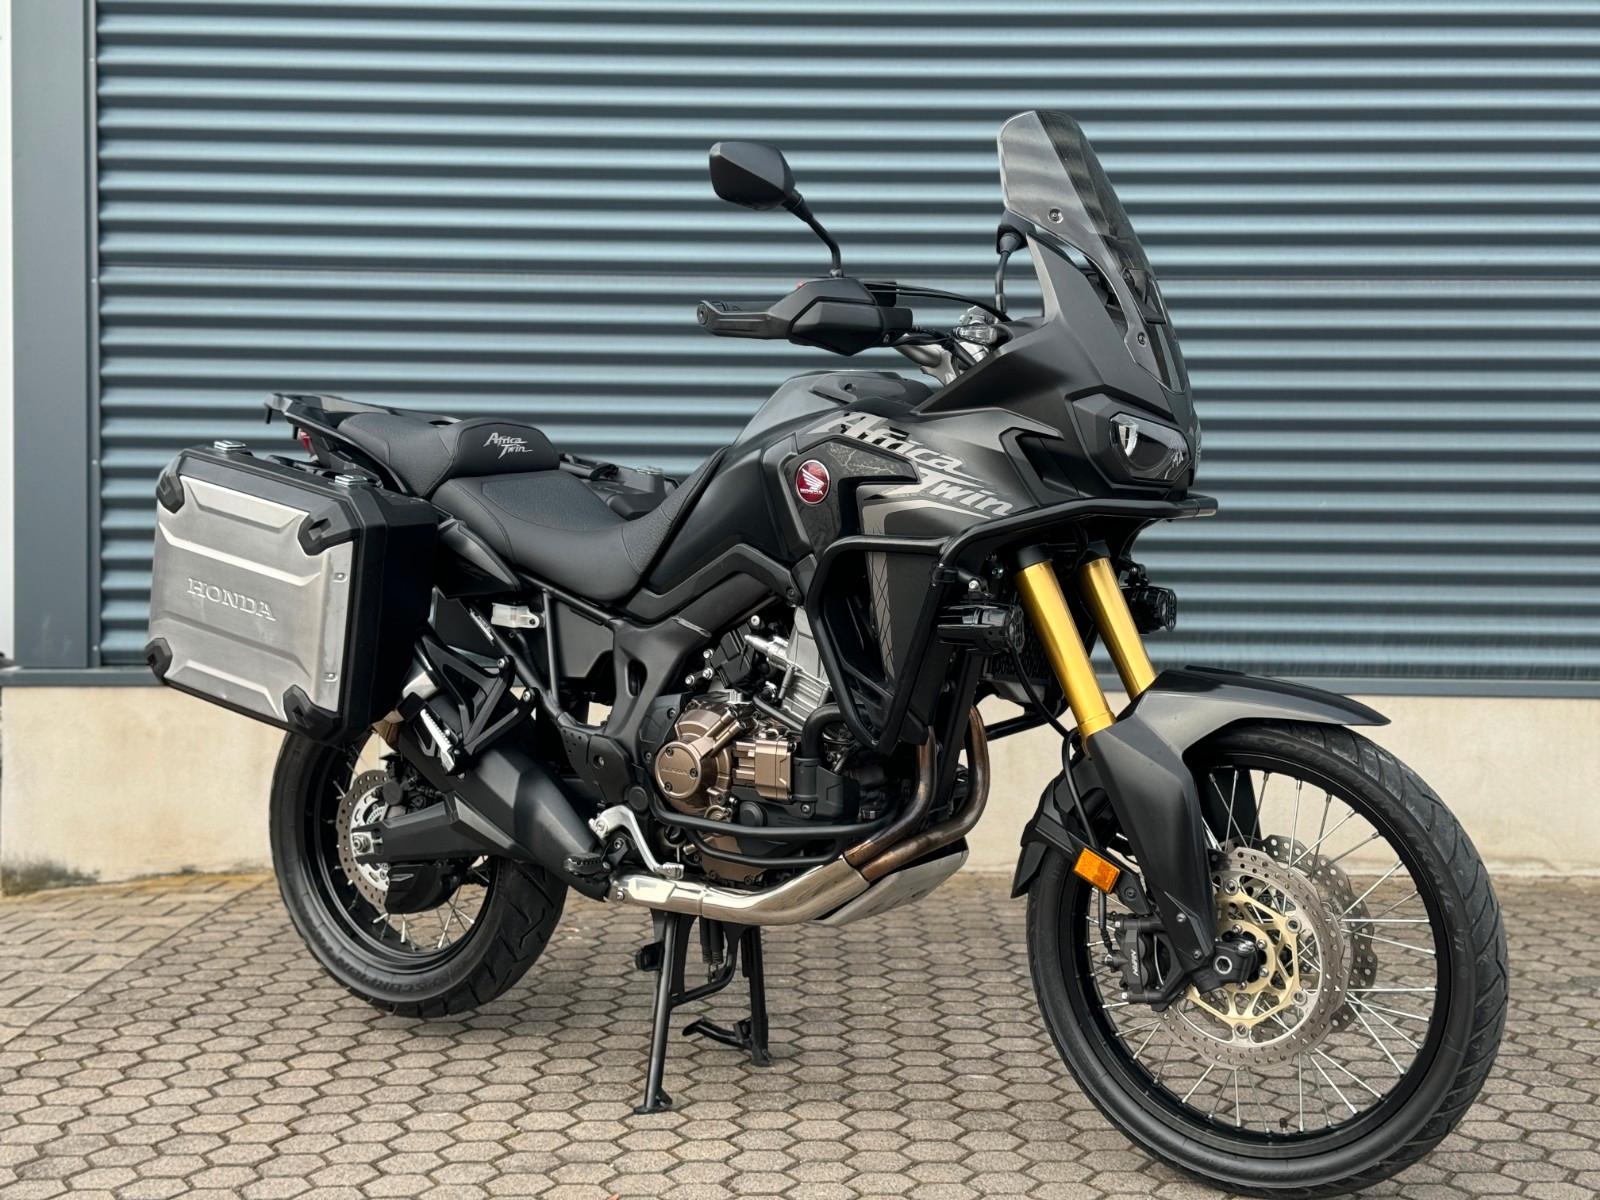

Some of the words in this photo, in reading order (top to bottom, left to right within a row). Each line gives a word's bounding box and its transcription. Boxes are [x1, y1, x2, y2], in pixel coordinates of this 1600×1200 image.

[482, 432, 528, 447] Africa
[497, 443, 533, 459] Twin
[806, 411, 988, 484] Africa
[881, 465, 1014, 516] Twin
[186, 576, 277, 621] HONDA
